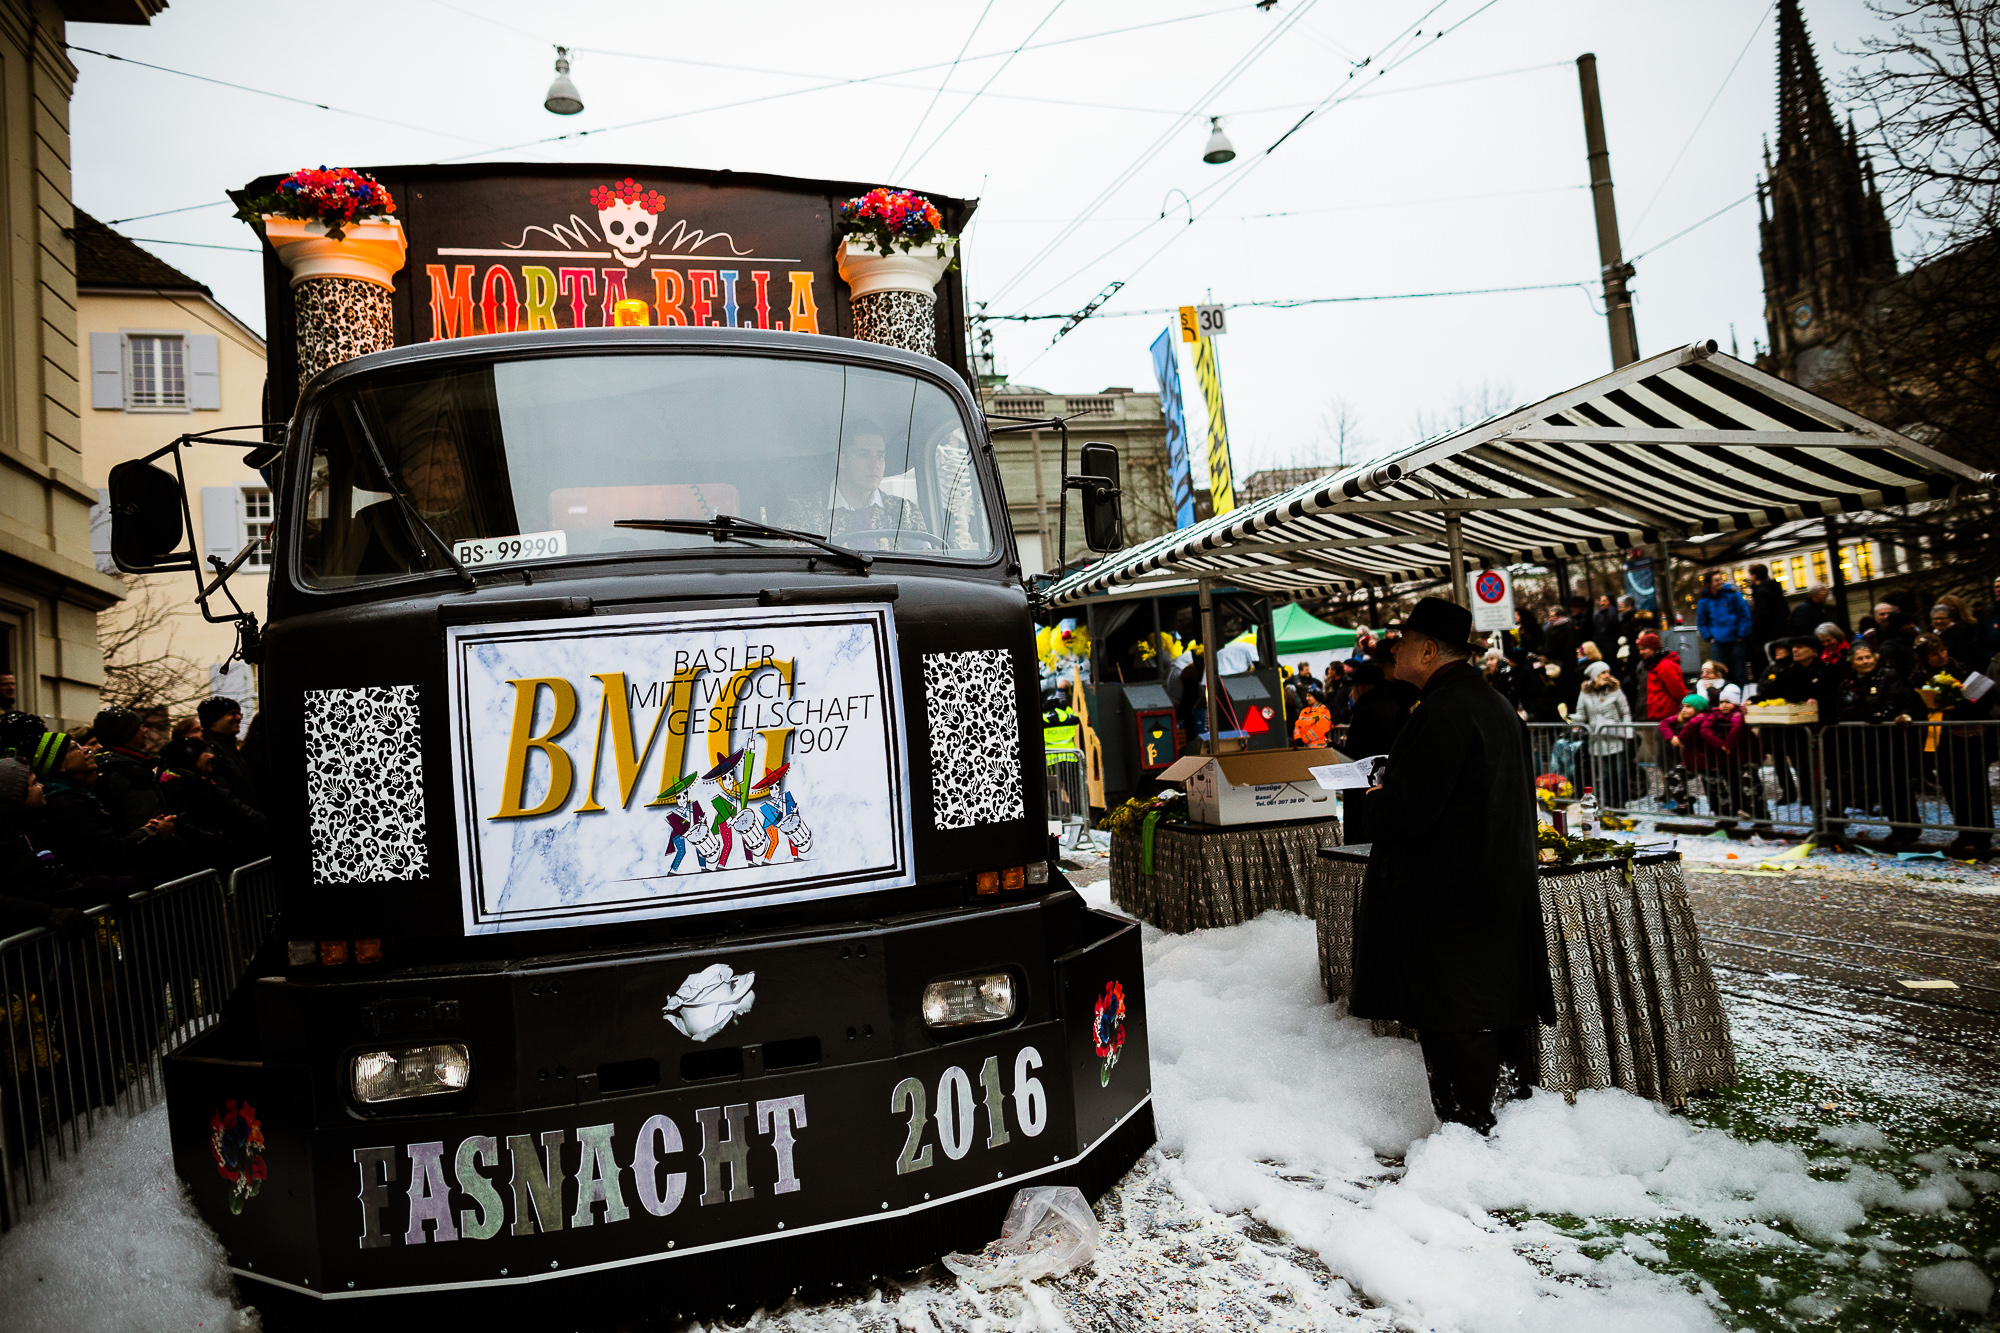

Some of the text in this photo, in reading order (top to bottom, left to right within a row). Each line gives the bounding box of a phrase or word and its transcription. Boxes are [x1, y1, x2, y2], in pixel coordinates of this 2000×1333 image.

[426, 264, 819, 342] MORTA BELLA
[1200, 309, 1224, 330] 30
[673, 644, 777, 676] BASLER
[629, 677, 806, 710] MITTWOCH-
[667, 694, 875, 736] GESELLSCHAFT
[487, 656, 796, 821] BMG
[790, 725, 849, 756] 1907
[353, 1046, 1048, 1250] FASNACHT 2016
